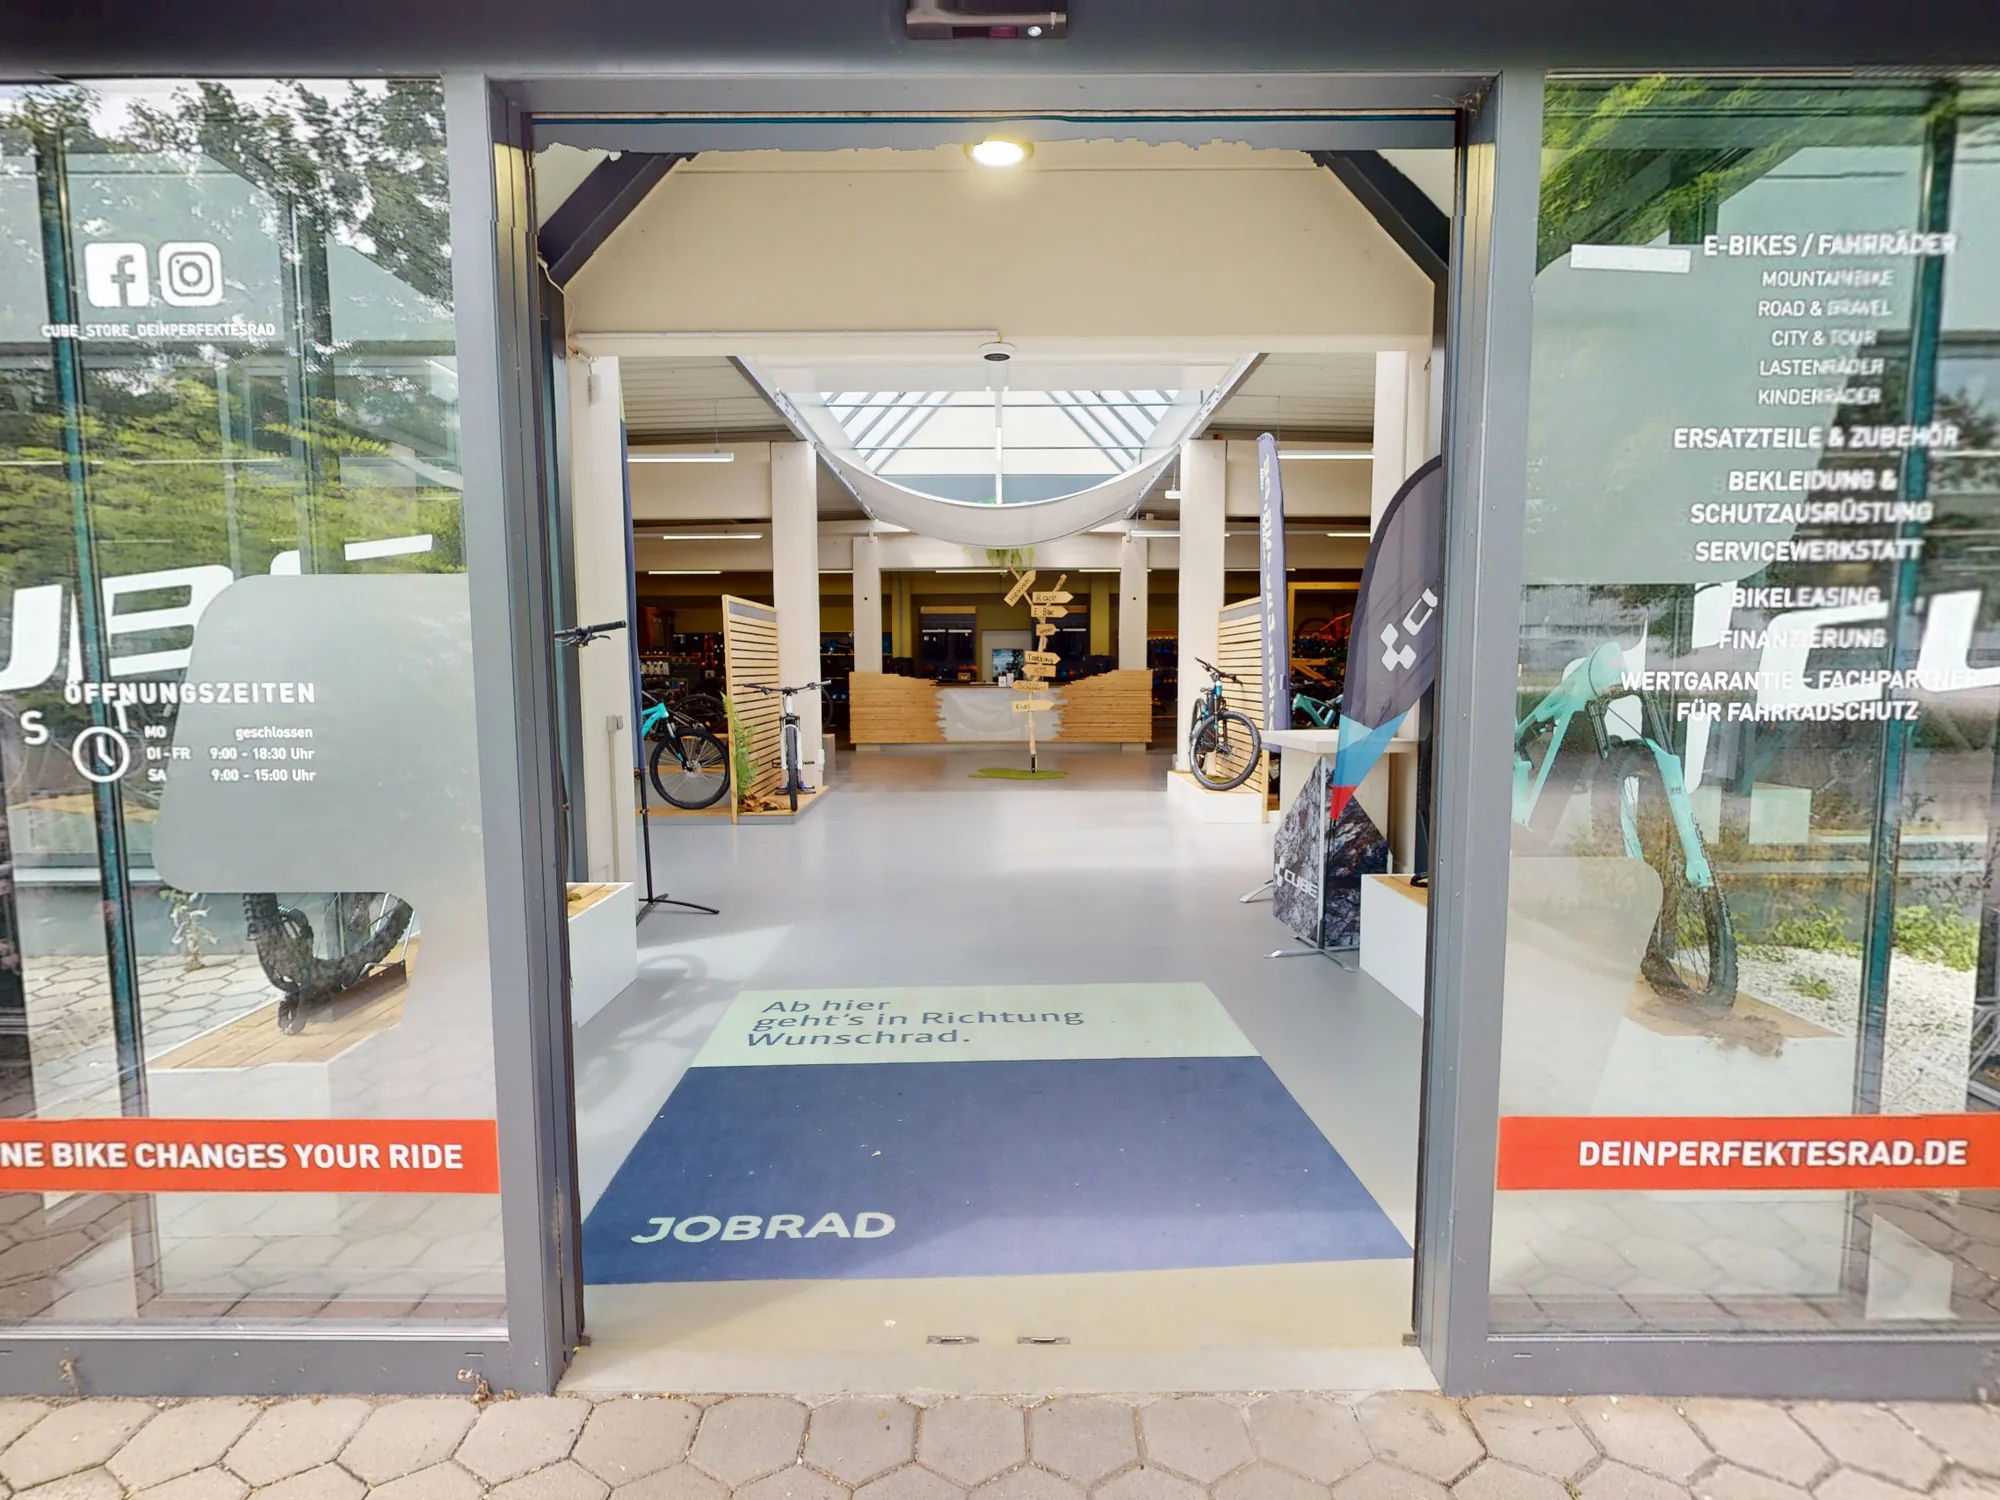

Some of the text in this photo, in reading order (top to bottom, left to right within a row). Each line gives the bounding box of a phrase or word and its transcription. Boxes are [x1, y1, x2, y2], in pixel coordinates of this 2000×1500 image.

[1703, 234, 1797, 256] E-BIKES
[1801, 233, 1814, 257] /
[1758, 300, 1804, 316] ROAD
[1809, 300, 1823, 316] &
[41, 323, 276, 340] CUBE_STORE_DEINPERFEKTESRAD
[1771, 329, 1877, 346] CITY & TOUR
[1674, 422, 1960, 449] ERSATZTEILE & ZUBEHÖR
[1728, 469, 1897, 491] BEKLEIDUNG &
[1690, 498, 1934, 524] SCHUTZAUSRÜSTUNG
[1695, 539, 1924, 562] SERVICEWERKSTATT
[1036, 594, 1057, 602] Race
[1732, 587, 1881, 608] BIKELEASING
[1720, 629, 1886, 650] FINANZIERUNG
[64, 679, 315, 704] ÖFFNUNGSZEITEN
[1620, 671, 1792, 692] WERTGARANTIE
[1677, 699, 1919, 722] FÜR FAHRRADSCHUTZ
[144, 725, 313, 740] MO geschlossen
[210, 747, 237, 760] 9:00
[252, 747, 286, 760] 18:30
[290, 747, 315, 760] Uhr
[147, 769, 167, 782] SA
[211, 769, 239, 782] 9:00
[254, 769, 288, 782] 15:00
[292, 769, 316, 782] Uhr
[1284, 868, 1318, 899] CUBE
[762, 998, 891, 1013] Ab hier
[752, 1008, 1084, 1031] geht's in Richtung
[747, 1028, 971, 1047] Wunschrad.
[51, 1142, 127, 1169] BIKE
[134, 1142, 287, 1169] CHANGES
[293, 1143, 381, 1169] YOUR
[389, 1143, 464, 1169] RIDE
[1578, 1139, 1968, 1168] DEINPERFEKTESRAD.DE
[630, 1211, 896, 1244] JOBRAD
